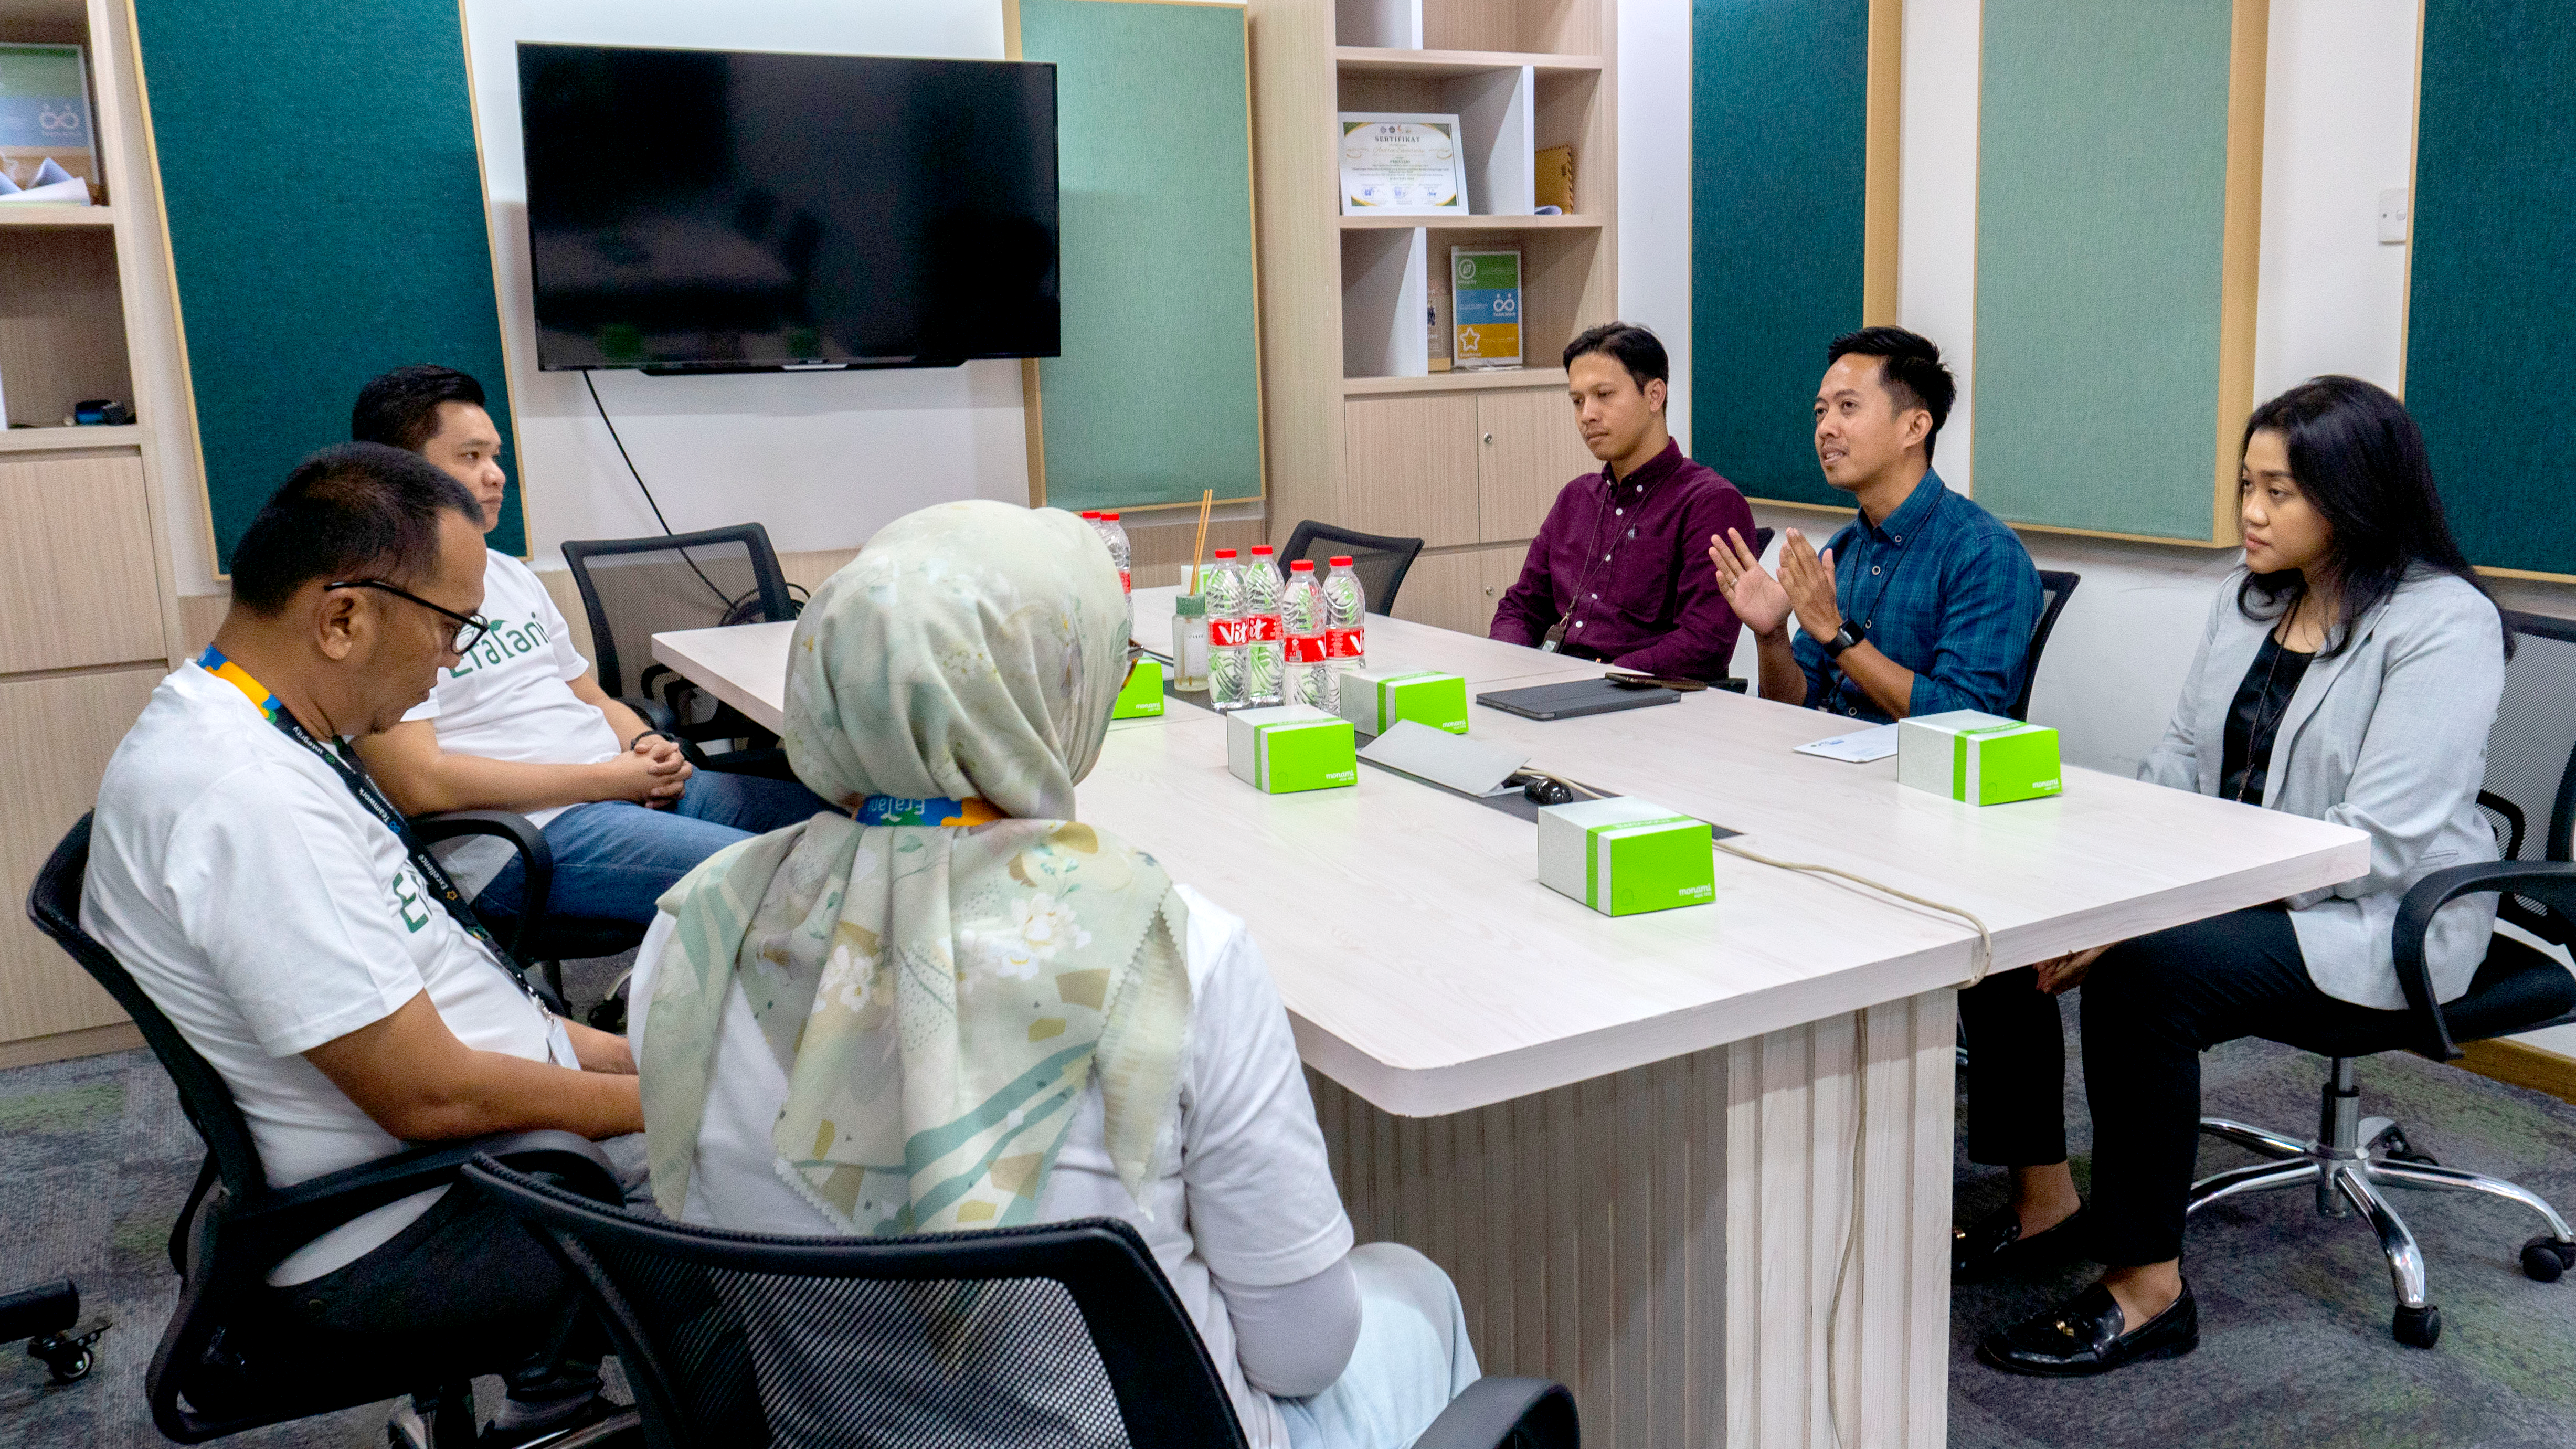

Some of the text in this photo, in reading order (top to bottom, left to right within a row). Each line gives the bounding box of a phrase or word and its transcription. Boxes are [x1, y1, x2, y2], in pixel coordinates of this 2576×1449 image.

[1218, 621, 1248, 644] Vit
[1249, 618, 1267, 640] it
[1443, 719, 1466, 728] monami
[1326, 769, 1354, 779] monami
[2032, 778, 2059, 788] monami
[358, 787, 390, 823] Teamwork
[418, 853, 448, 890] Excellence
[1679, 883, 1712, 896] monami
